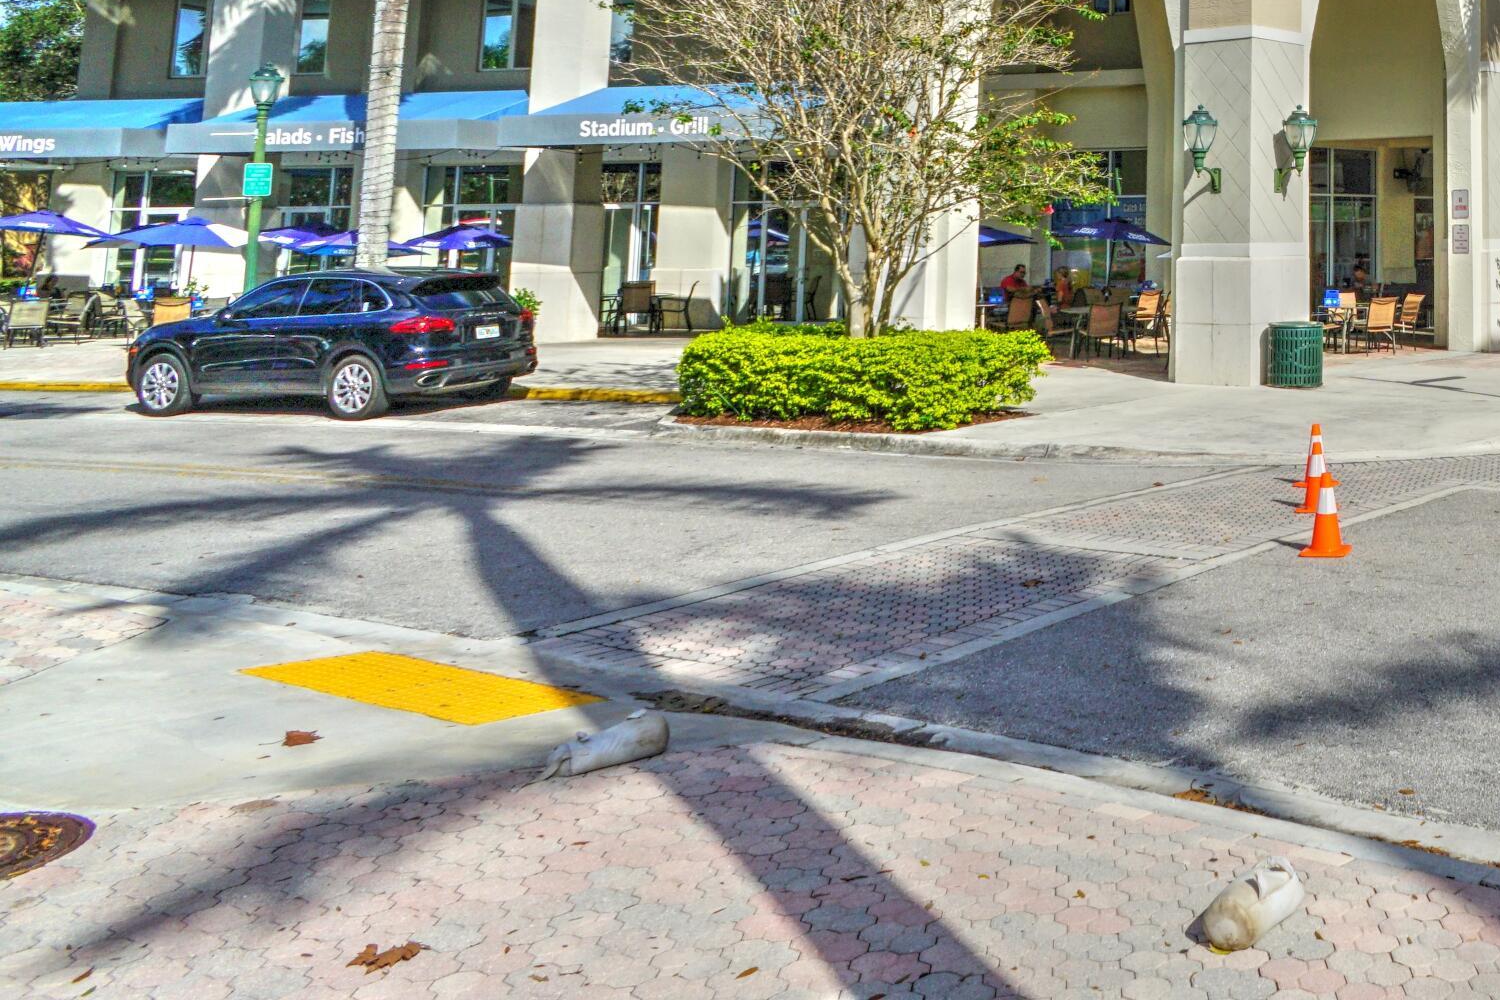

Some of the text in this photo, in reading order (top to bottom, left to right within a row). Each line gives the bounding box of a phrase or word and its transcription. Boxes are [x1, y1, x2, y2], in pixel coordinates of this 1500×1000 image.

[328, 126, 365, 145] Fish
[579, 116, 709, 138] Stadium Grill
[0, 135, 56, 153] Wings
